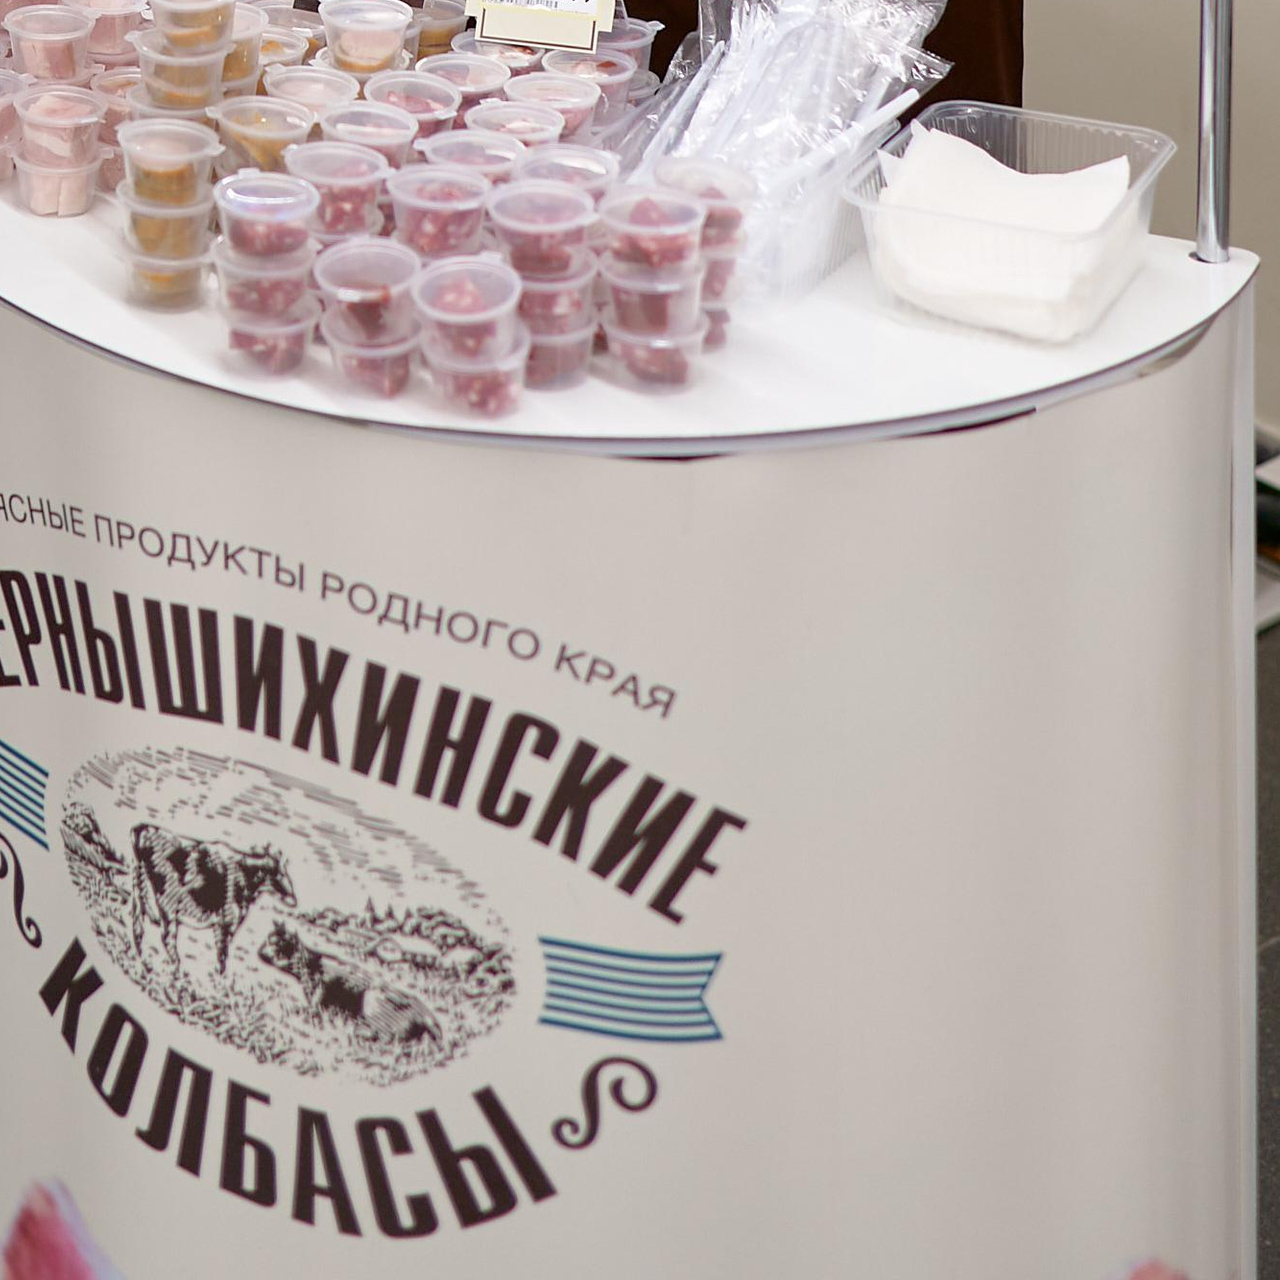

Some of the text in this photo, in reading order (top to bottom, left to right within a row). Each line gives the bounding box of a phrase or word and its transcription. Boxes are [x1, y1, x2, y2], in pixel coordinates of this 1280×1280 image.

[94, 513, 305, 593] ПРОДУКТЫ
[320, 571, 540, 660] РОДНОГО
[554, 643, 677, 719] КРАЯ
[38, 937, 558, 1240] КОЛБАСЫ
